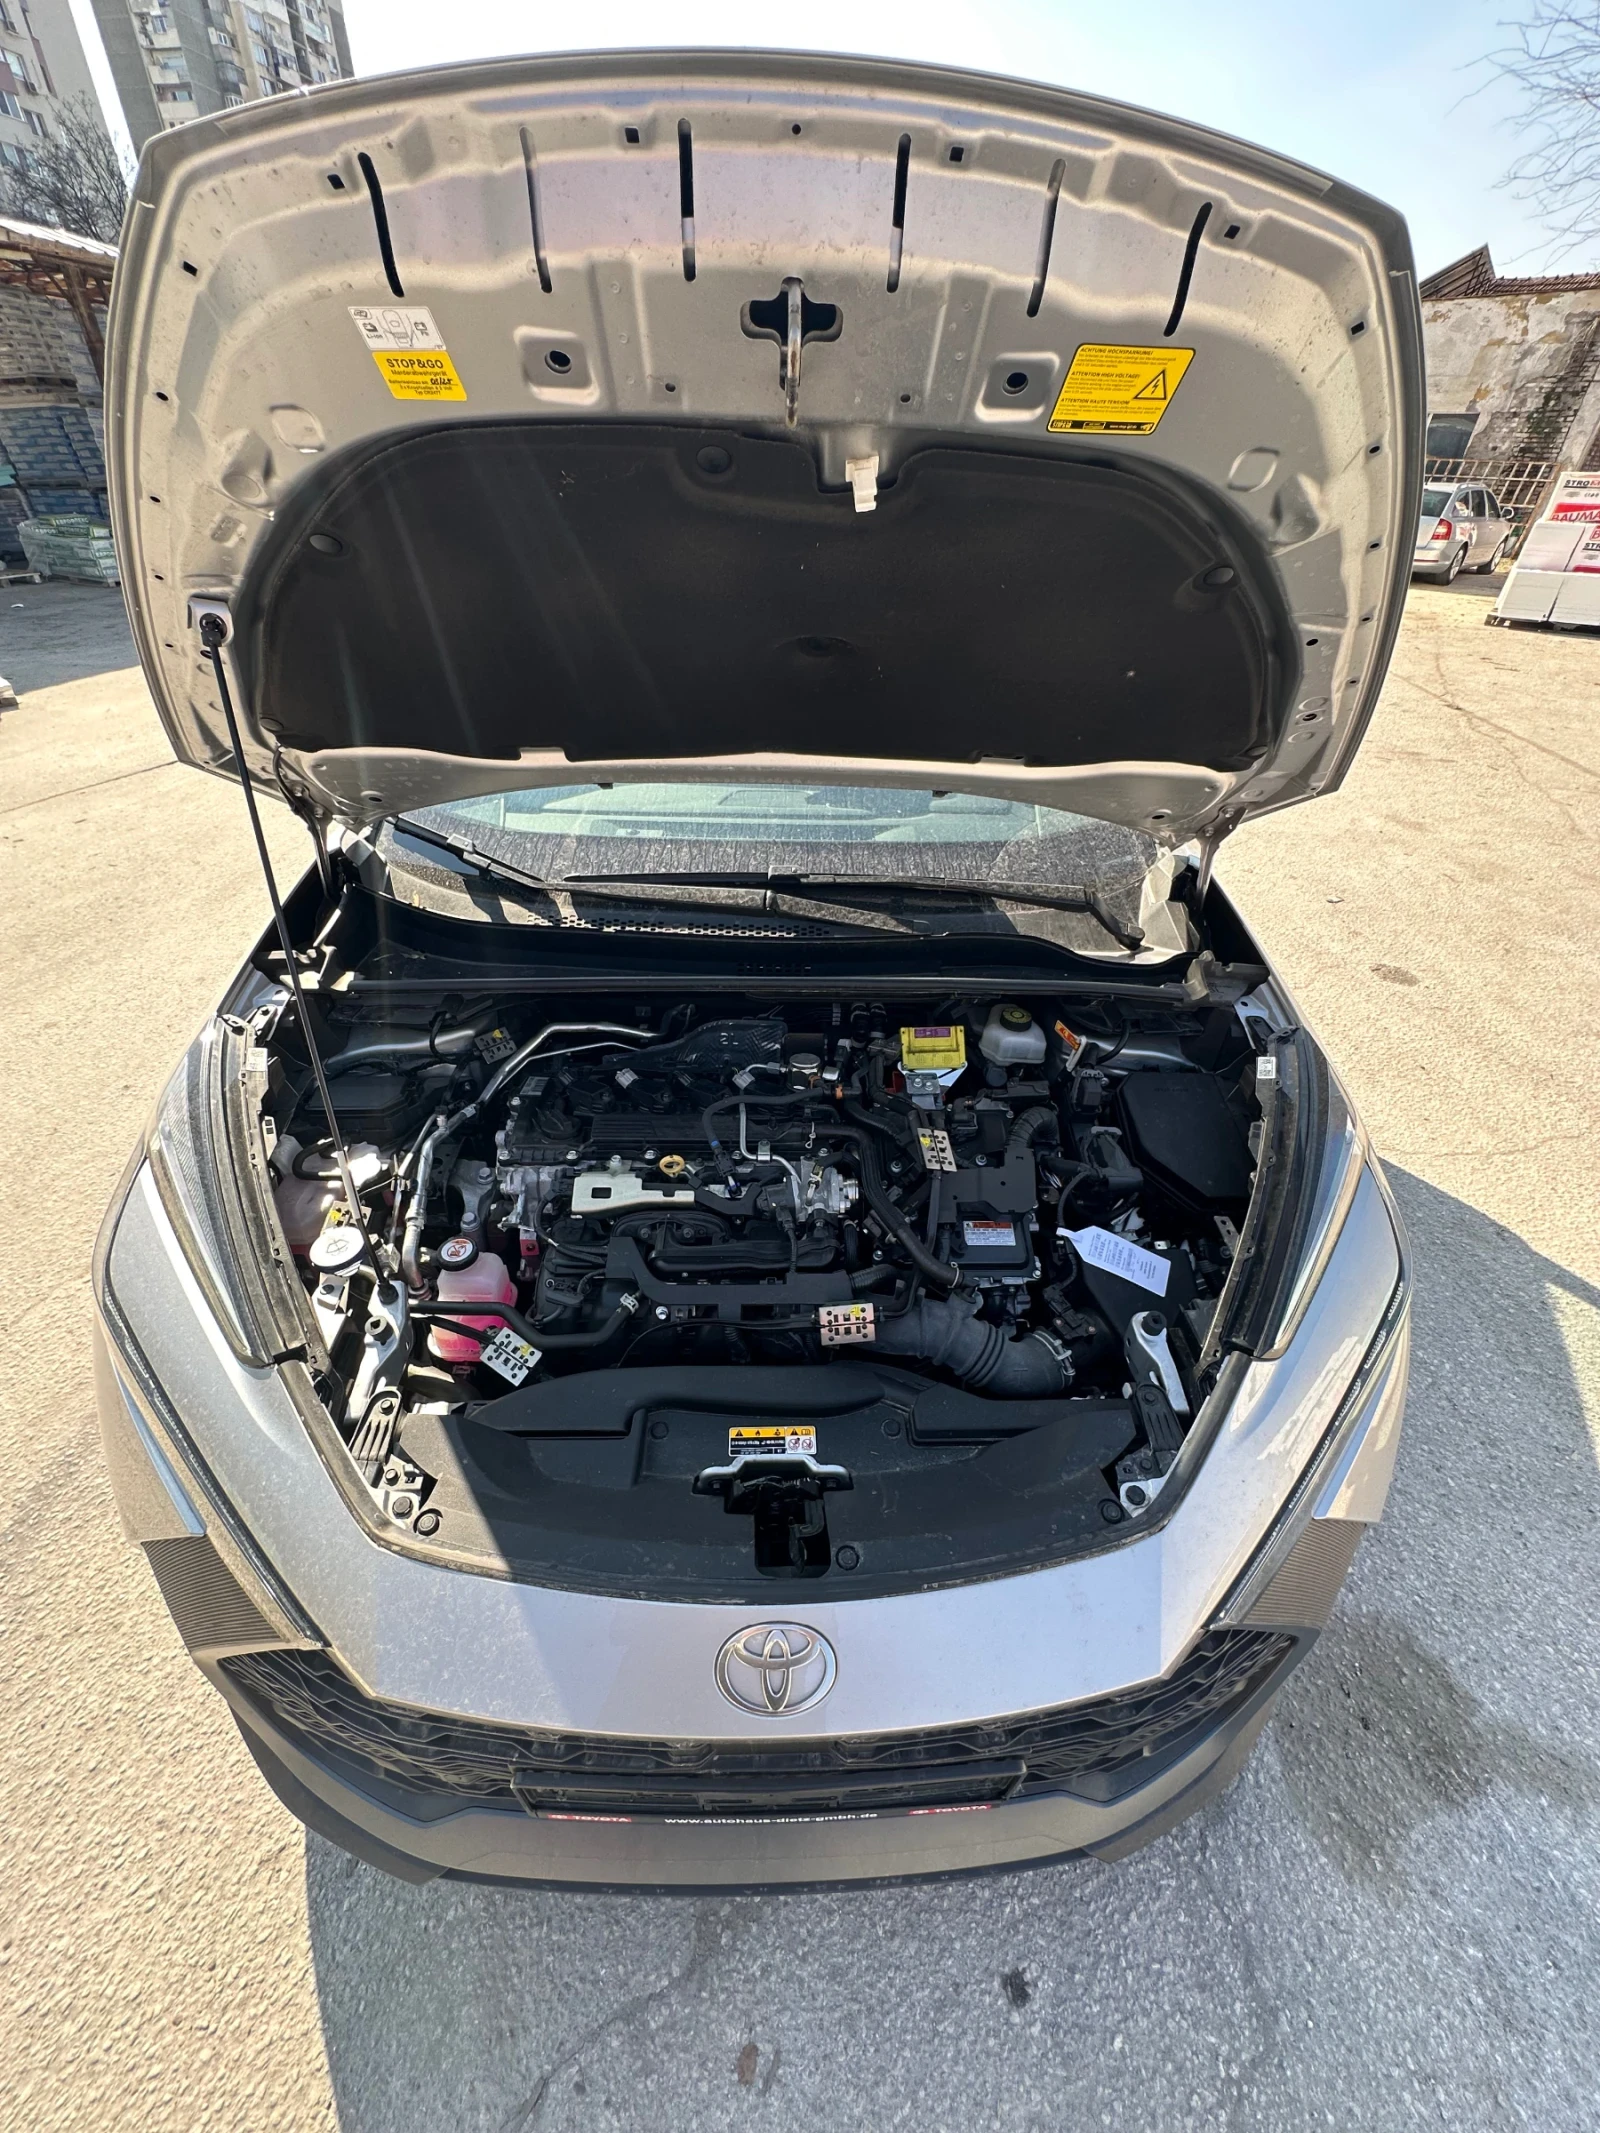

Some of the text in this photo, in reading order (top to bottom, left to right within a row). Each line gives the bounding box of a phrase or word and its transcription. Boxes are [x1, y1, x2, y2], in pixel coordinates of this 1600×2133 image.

[386, 358, 444, 369] STOP&GO
[934, 1805, 988, 1813] TOYOTA
[573, 1814, 629, 1822] TOYOTA
[664, 1813, 878, 1824] www.autohaus-dietz-gmbh.de
